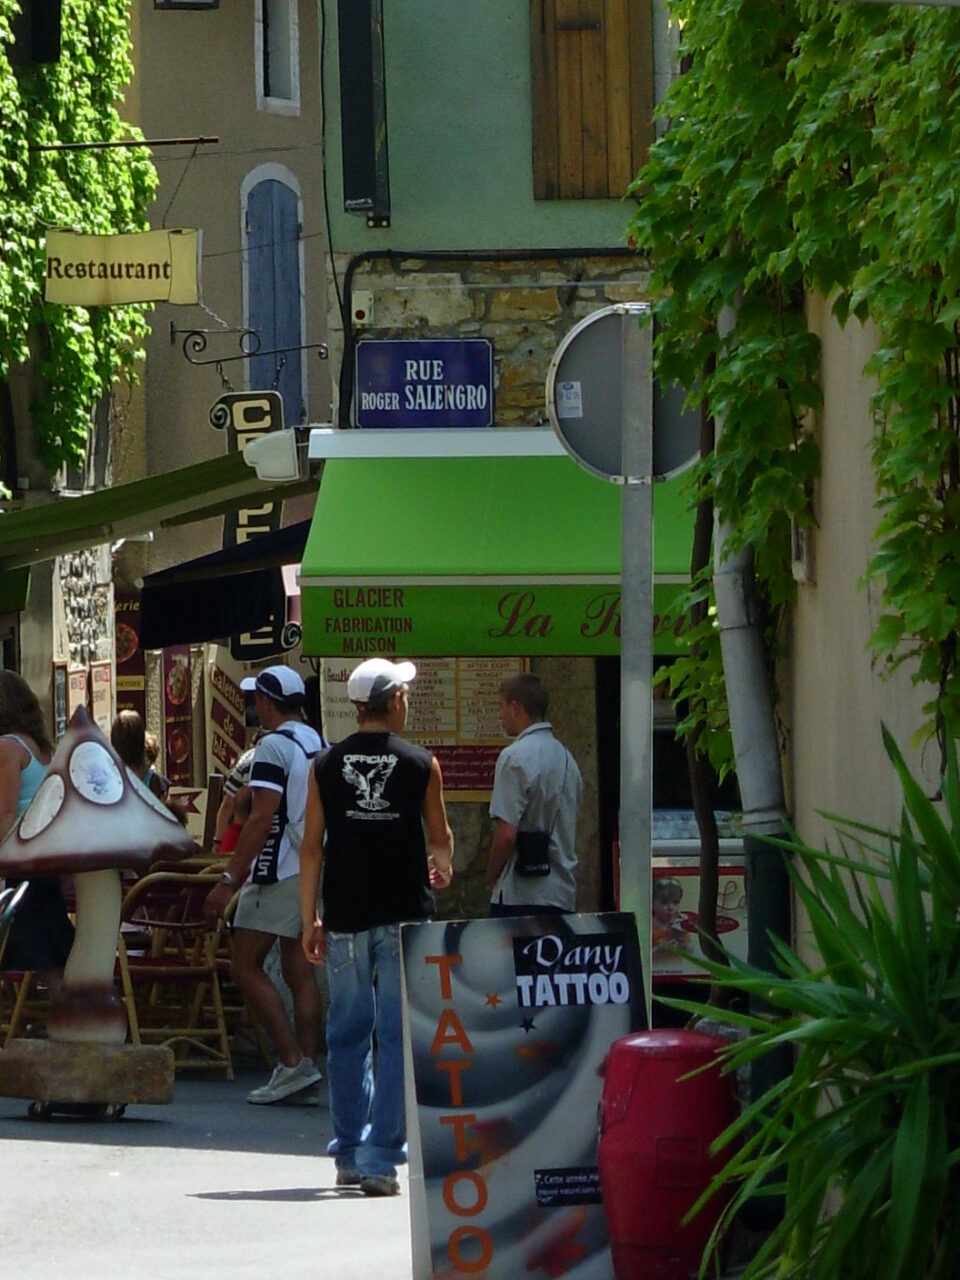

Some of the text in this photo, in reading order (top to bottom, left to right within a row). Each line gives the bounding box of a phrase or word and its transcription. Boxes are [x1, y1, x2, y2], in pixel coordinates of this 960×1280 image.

[47, 257, 171, 279] Restaurant
[405, 360, 444, 380] RUE
[361, 384, 487, 410] ROGER SALENGRO
[334, 588, 404, 608] GLACIER
[325, 618, 413, 632] FABRICATION
[490, 592, 553, 638] La
[342, 637, 396, 653] MAISON
[223, 714, 234, 735] de
[522, 934, 623, 975] Dany
[516, 972, 630, 1007] TATTOO
[425, 954, 495, 1273] TATTOO
